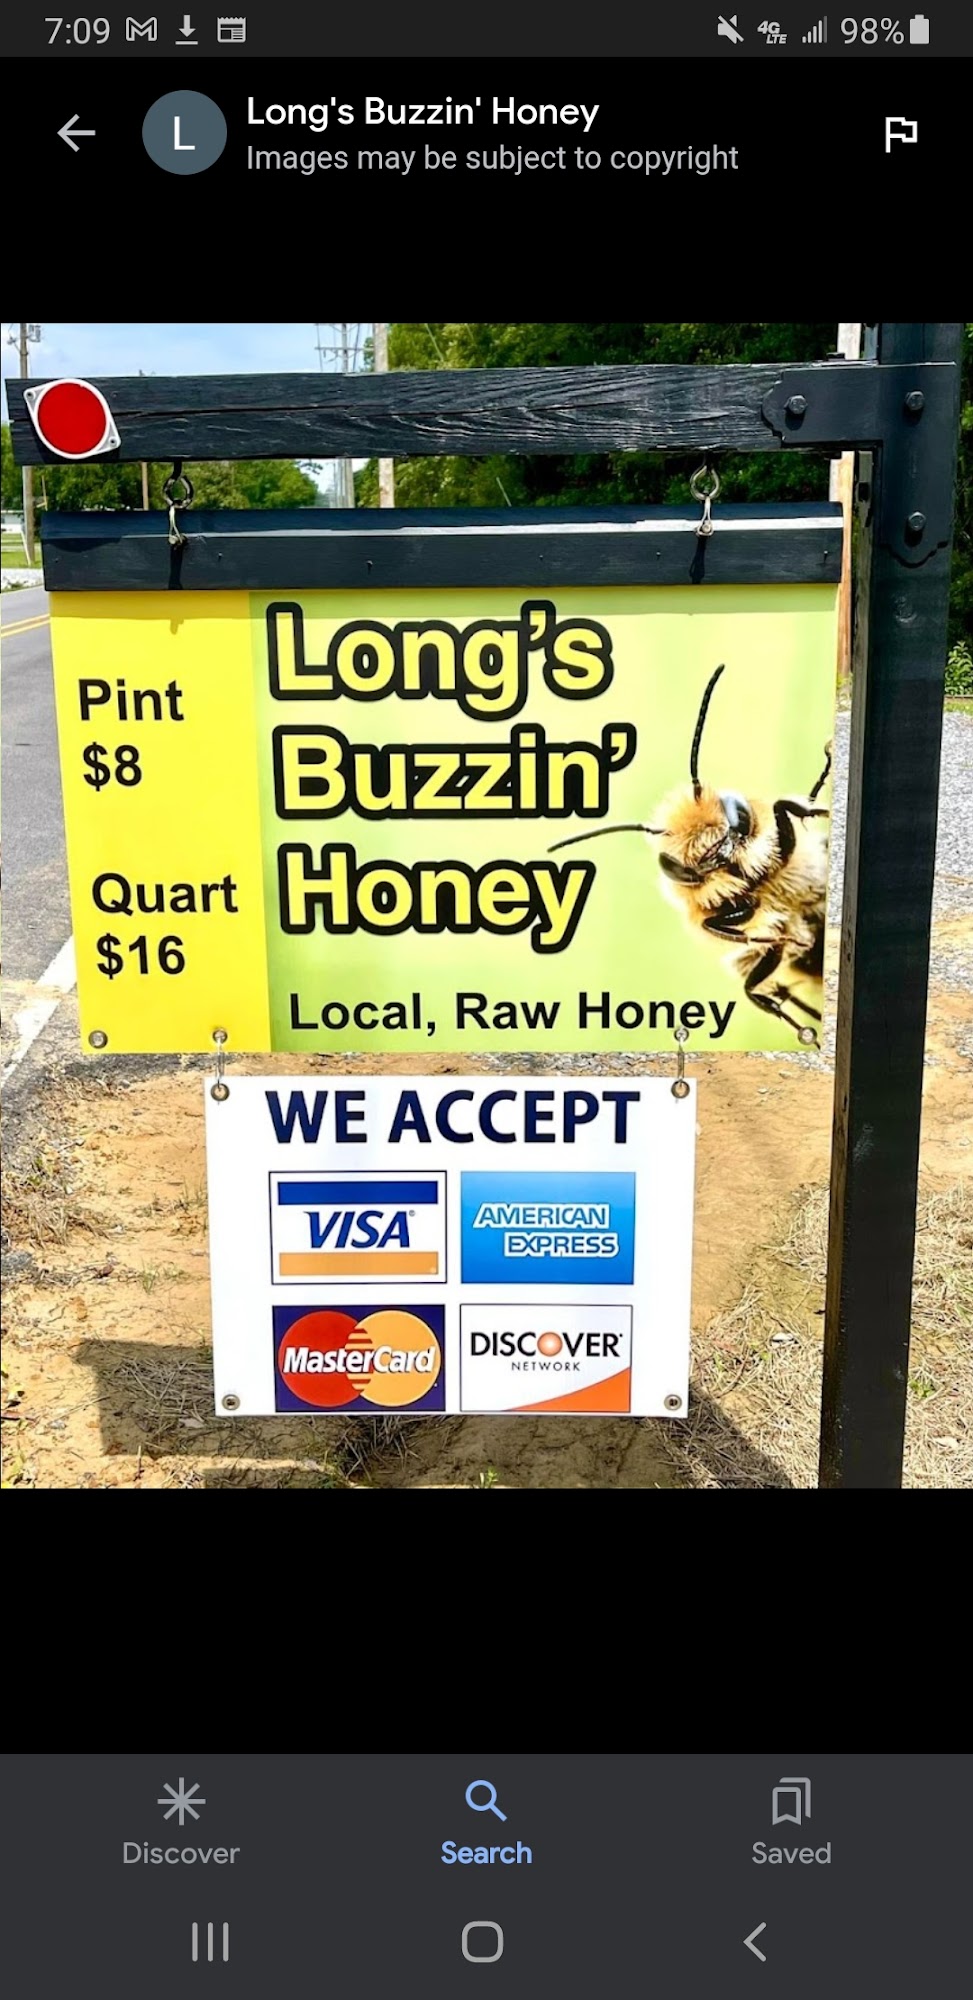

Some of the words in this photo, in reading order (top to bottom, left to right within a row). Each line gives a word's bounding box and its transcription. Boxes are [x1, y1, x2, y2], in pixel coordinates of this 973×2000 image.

[266, 601, 614, 721] Long's
[78, 678, 185, 722] Pint
[82, 742, 143, 792] $8
[272, 722, 637, 820] Buzzin'
[91, 872, 239, 917] Quart
[277, 843, 597, 954] Honey
[96, 932, 186, 980] $16
[289, 993, 436, 1037] Local,
[456, 992, 561, 1030] Raw
[579, 992, 736, 1039] Honey
[265, 1090, 368, 1144] WE
[388, 1089, 641, 1144] ACCEPT
[303, 1210, 410, 1249] VISA
[475, 1204, 610, 1228] AMERICAN
[505, 1233, 619, 1256] EXPRESS
[282, 1345, 436, 1373] MasterCard
[470, 1332, 620, 1358] DISCOVER
[511, 1361, 581, 1372] NETWORK
